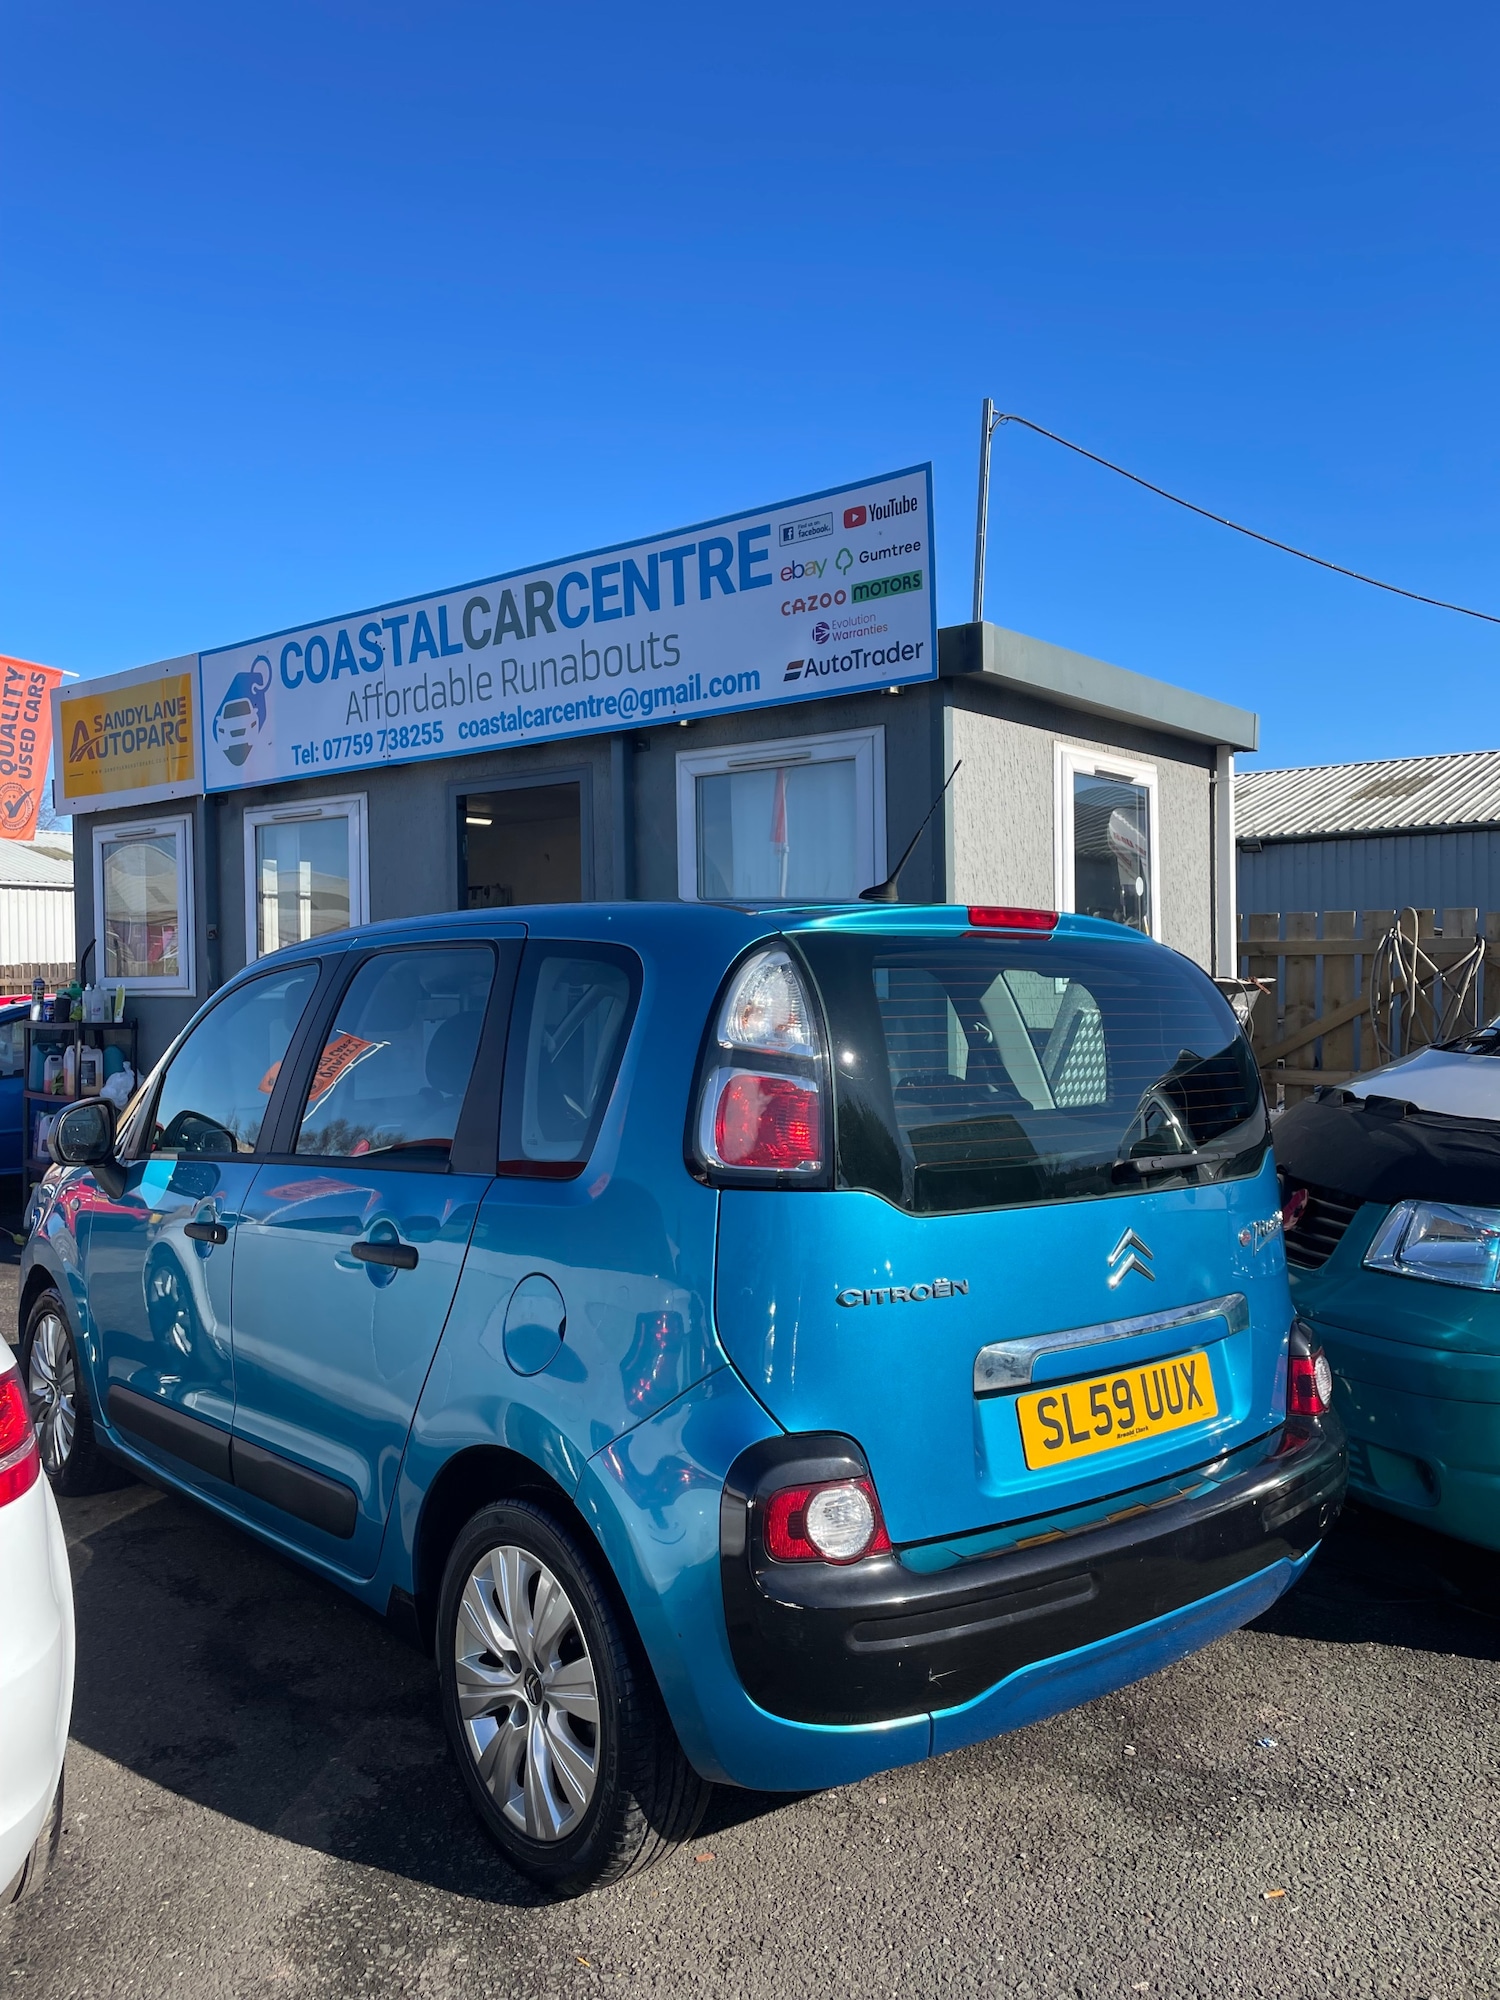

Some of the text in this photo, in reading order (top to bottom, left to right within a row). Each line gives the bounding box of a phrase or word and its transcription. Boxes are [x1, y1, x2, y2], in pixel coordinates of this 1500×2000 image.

[869, 495, 918, 521] YouTube
[780, 558, 828, 581] ebay
[859, 541, 921, 563] Gumtree
[280, 524, 772, 689] COASTALCARCENTRE
[781, 589, 847, 616] CAZOO
[832, 613, 877, 630] Evolution
[832, 623, 888, 641] Warranties
[345, 631, 681, 725] Affordable Runabouts
[804, 641, 924, 678] AutoTrader
[0, 665, 26, 777] QUALITY
[94, 696, 187, 733] SANDYLANE
[458, 669, 761, 740] coastalcarcentre@gmail.com
[18, 671, 47, 780] USED CARS
[69, 717, 188, 763] AUTOPARC
[291, 720, 444, 765] Tel: 07759 738255
[835, 1277, 970, 1308] CITROËN
[1037, 1360, 1204, 1450] SL59 UUX
